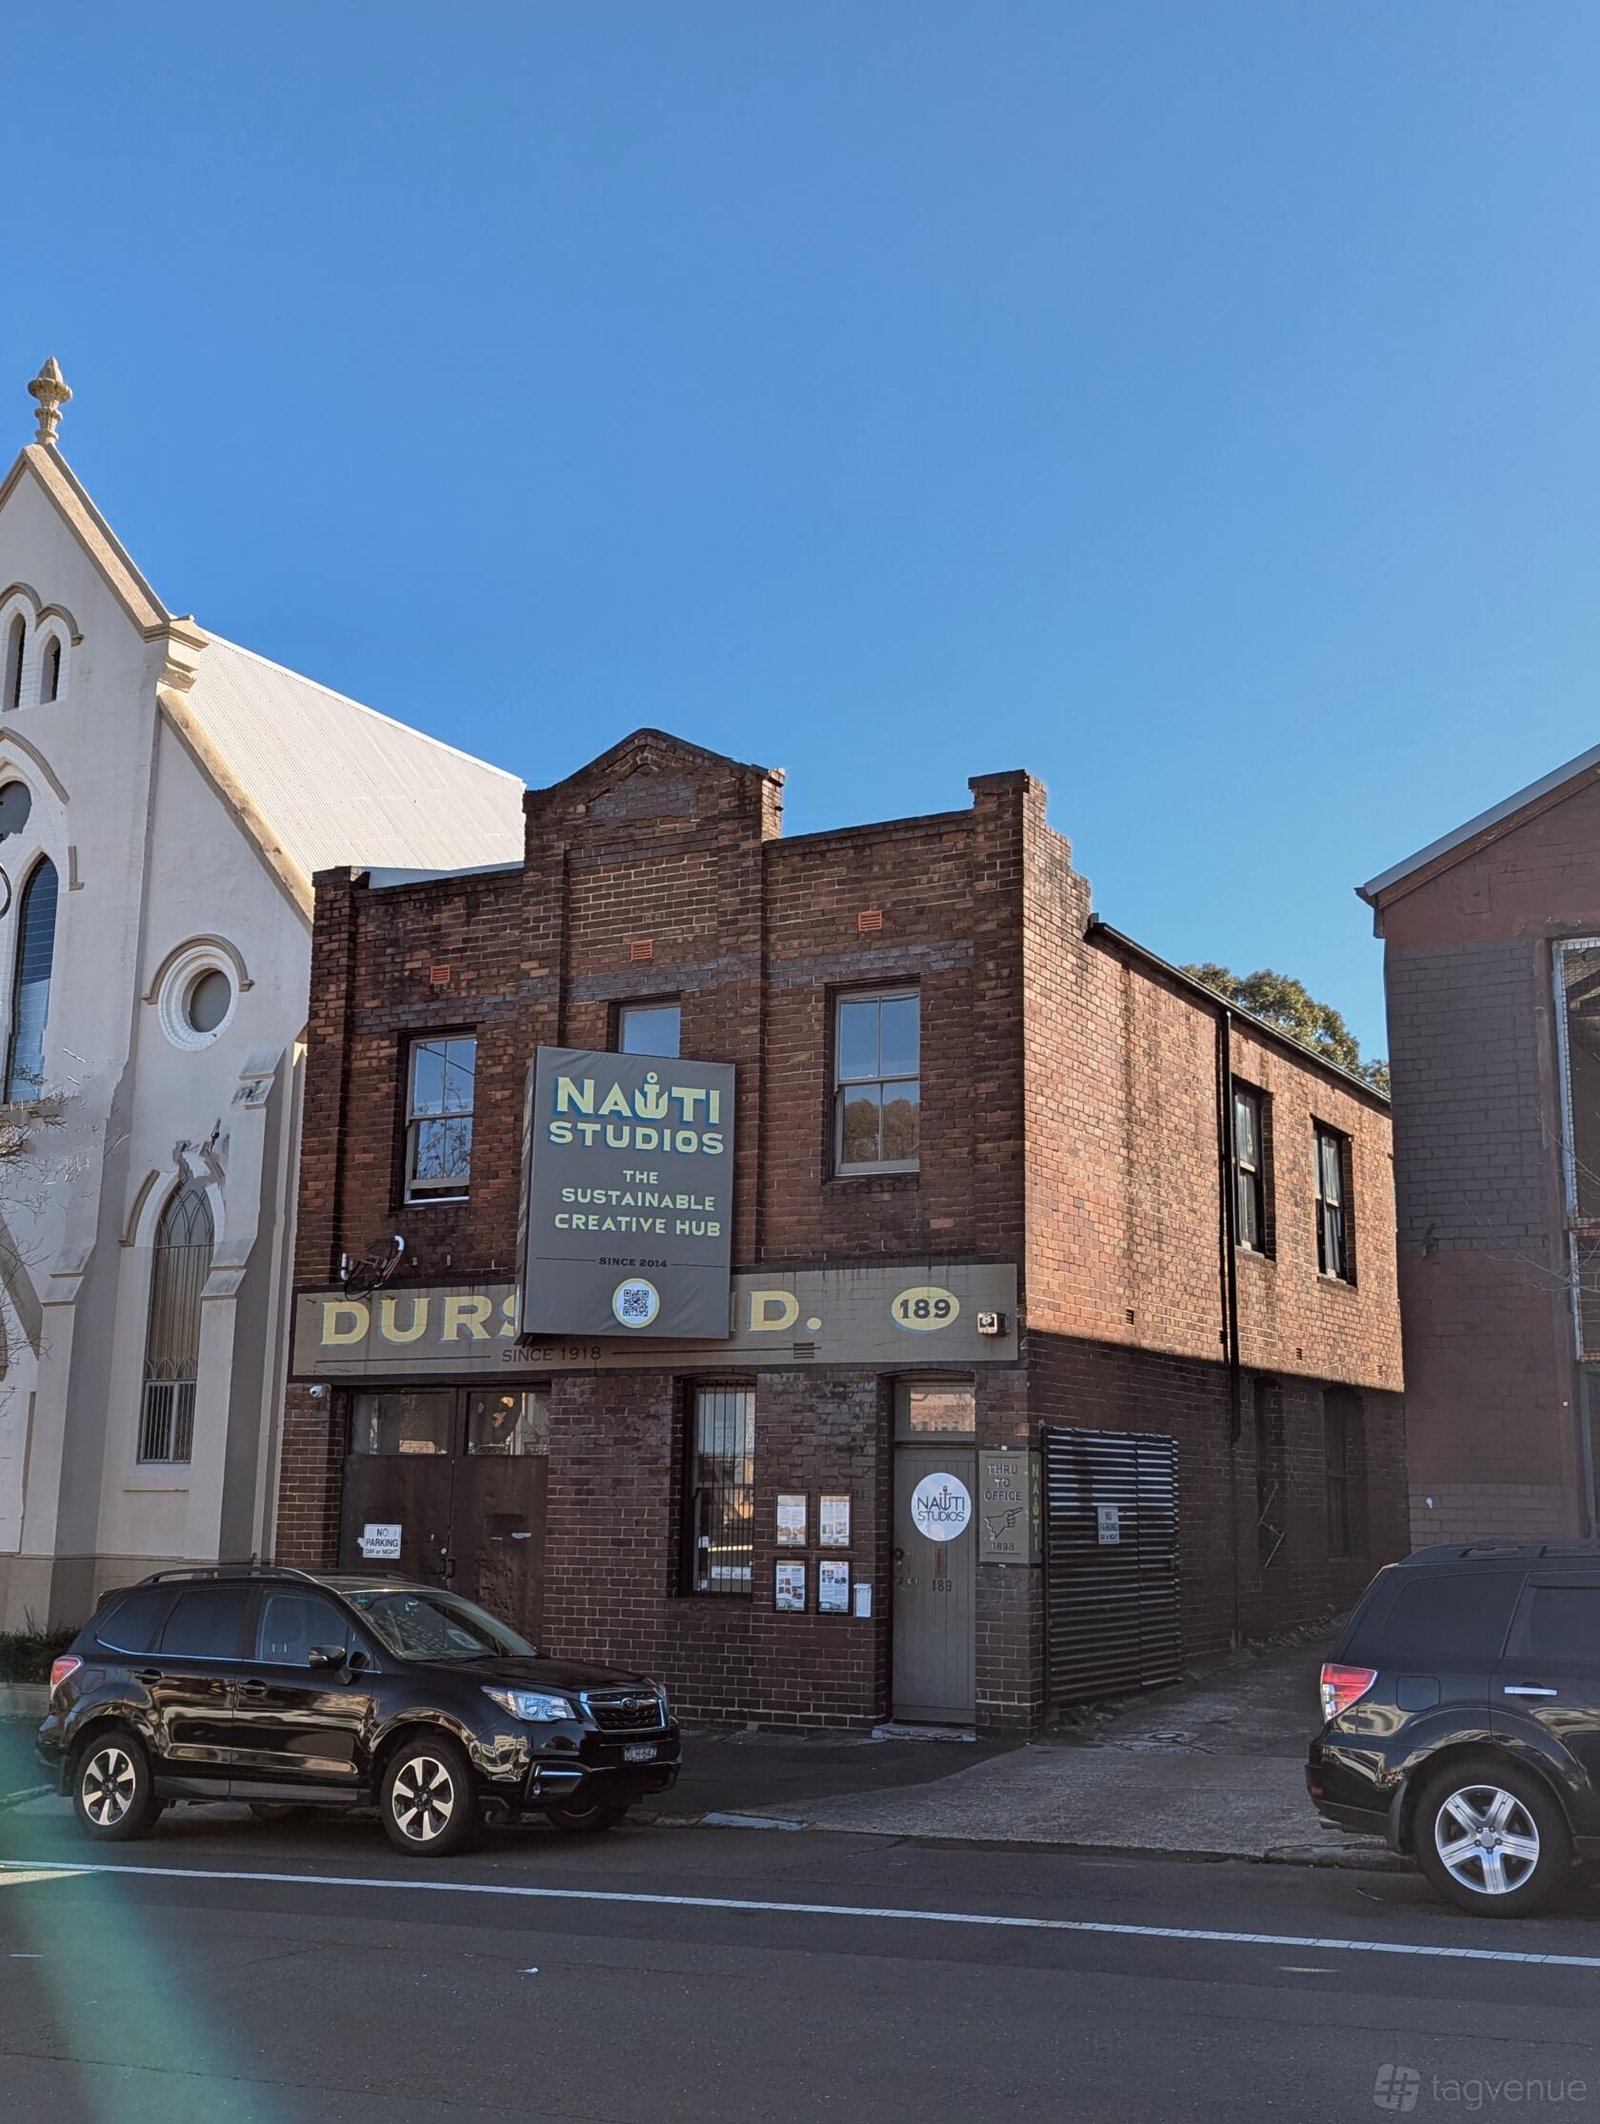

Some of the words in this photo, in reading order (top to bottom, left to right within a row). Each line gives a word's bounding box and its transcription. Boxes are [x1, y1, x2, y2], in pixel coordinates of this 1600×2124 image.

[555, 1072, 721, 1124] NAUTI
[549, 1121, 724, 1155] STUDIOS
[623, 1170, 658, 1184] THE
[561, 1188, 715, 1211] SUSTAINABLE
[554, 1213, 666, 1234] CREATIVE
[675, 1220, 721, 1237] HUB
[599, 1257, 636, 1267] SINCE
[639, 1258, 668, 1268] 2014
[900, 1298, 951, 1319] 189
[501, 1348, 554, 1363] SINCE
[560, 1346, 601, 1361] 1918
[987, 1464, 1018, 1475] THRU
[994, 1478, 1011, 1488] TO
[917, 1489, 965, 1511] NAUTI
[984, 1490, 1022, 1502] OFFICE
[918, 1511, 965, 1522] STUDIOS
[376, 1528, 389, 1537] NO
[366, 1539, 398, 1547] PARKING
